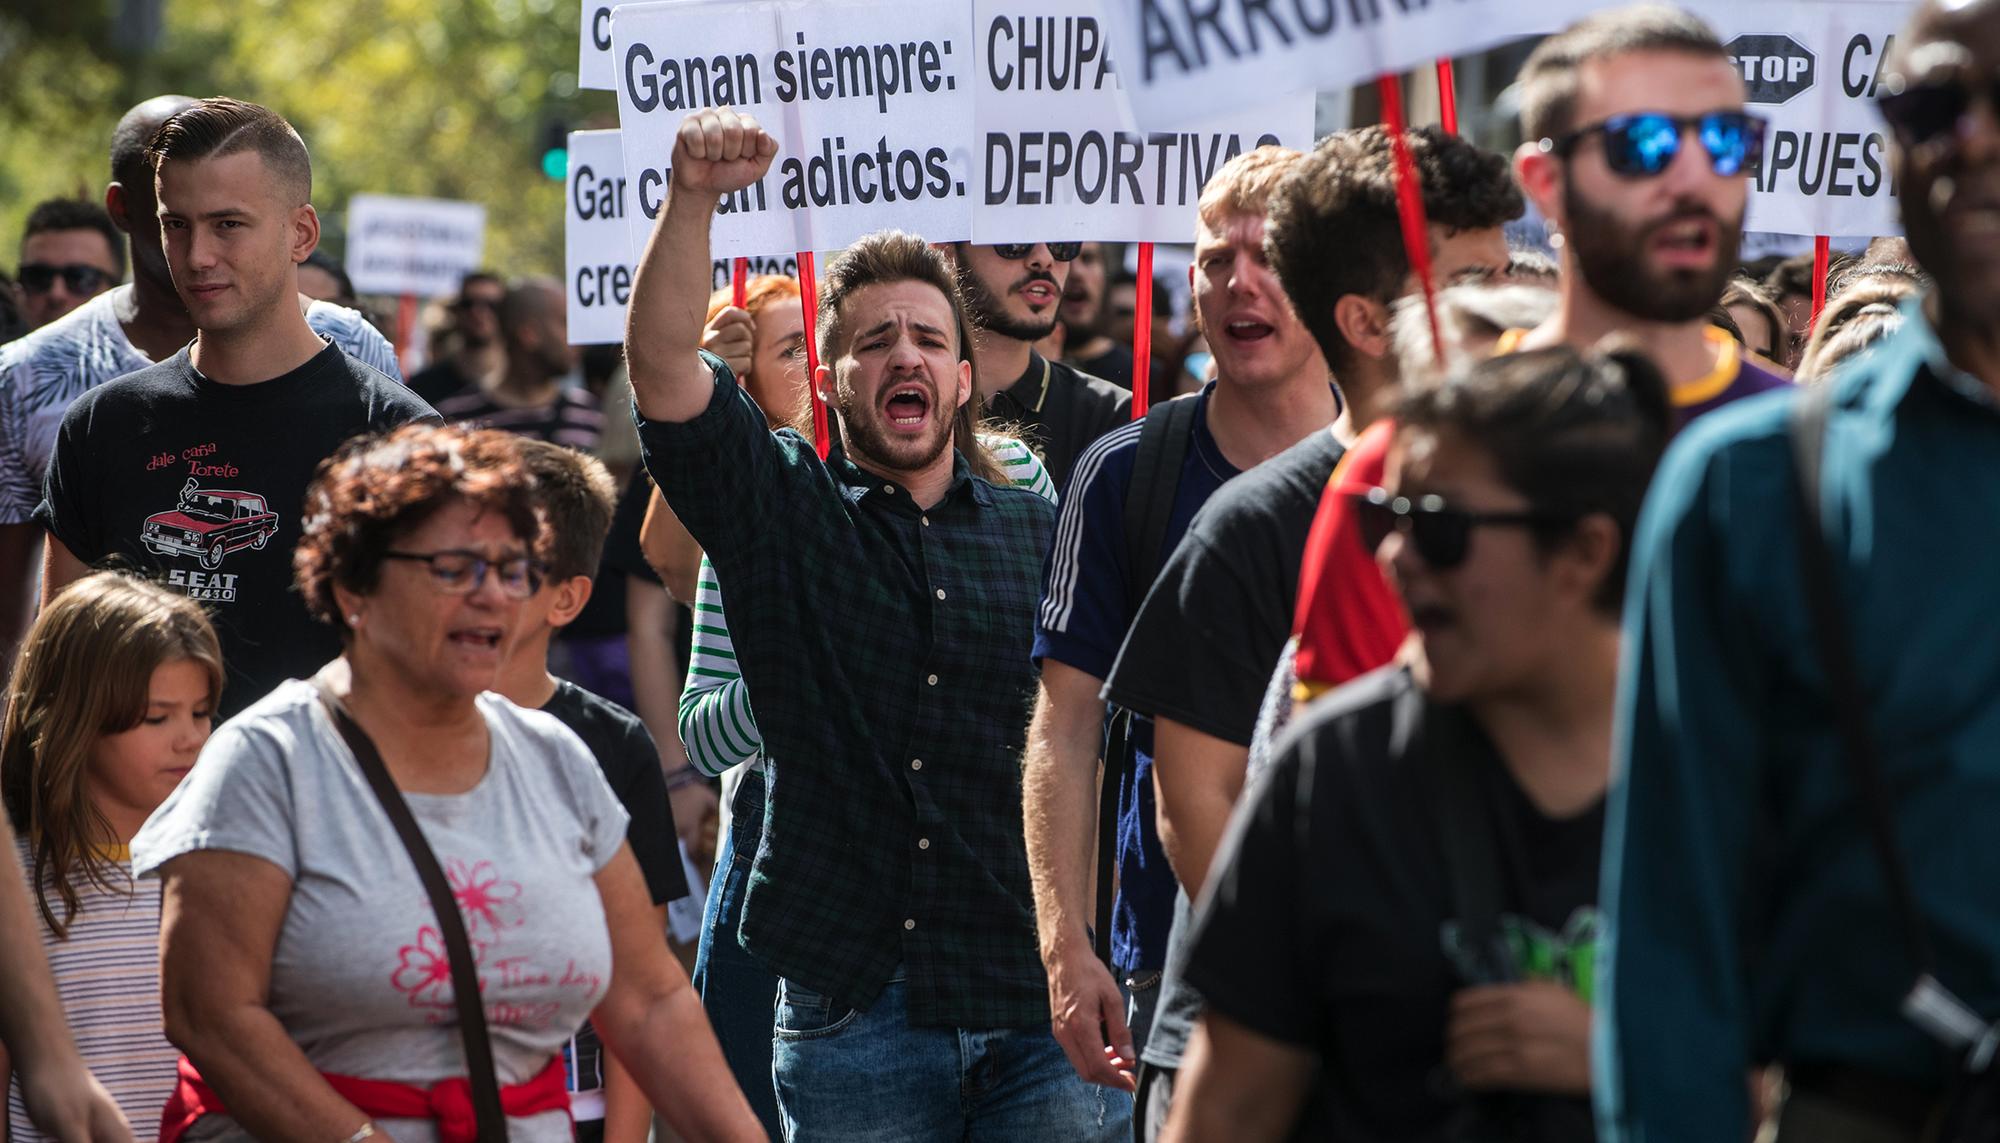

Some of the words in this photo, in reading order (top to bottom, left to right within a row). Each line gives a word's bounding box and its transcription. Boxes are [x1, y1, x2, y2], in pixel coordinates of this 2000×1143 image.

[625, 42, 761, 114] Ganan
[774, 31, 956, 114] siempre:
[782, 136, 966, 210] adictos.
[146, 452, 176, 471] dale
[182, 442, 217, 460] caña
[187, 460, 239, 478] Torete
[168, 569, 239, 589] SEAT
[191, 588, 234, 600] 1430
